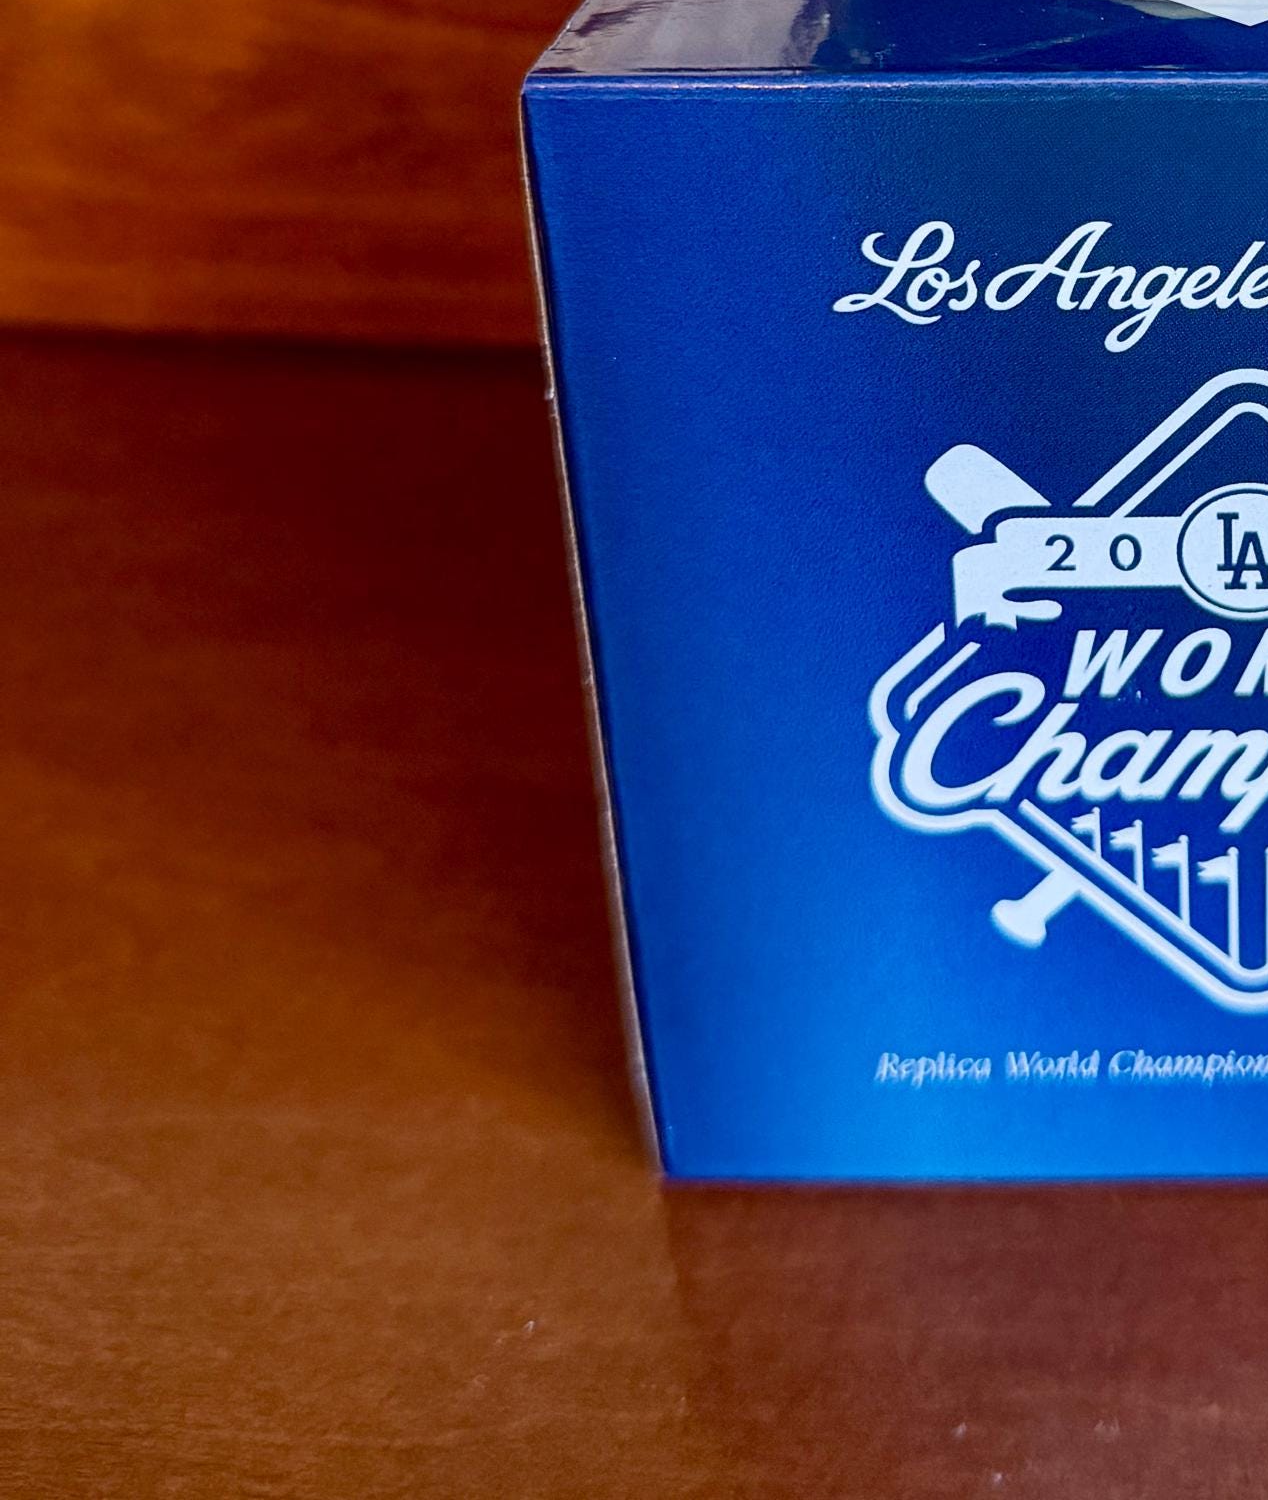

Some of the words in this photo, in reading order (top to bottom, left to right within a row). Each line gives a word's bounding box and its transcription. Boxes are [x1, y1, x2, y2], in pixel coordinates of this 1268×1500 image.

[832, 220, 977, 325] Los
[1045, 533, 1142, 572] 20
[875, 1051, 992, 1088] Replica
[1004, 1049, 1101, 1081] World
